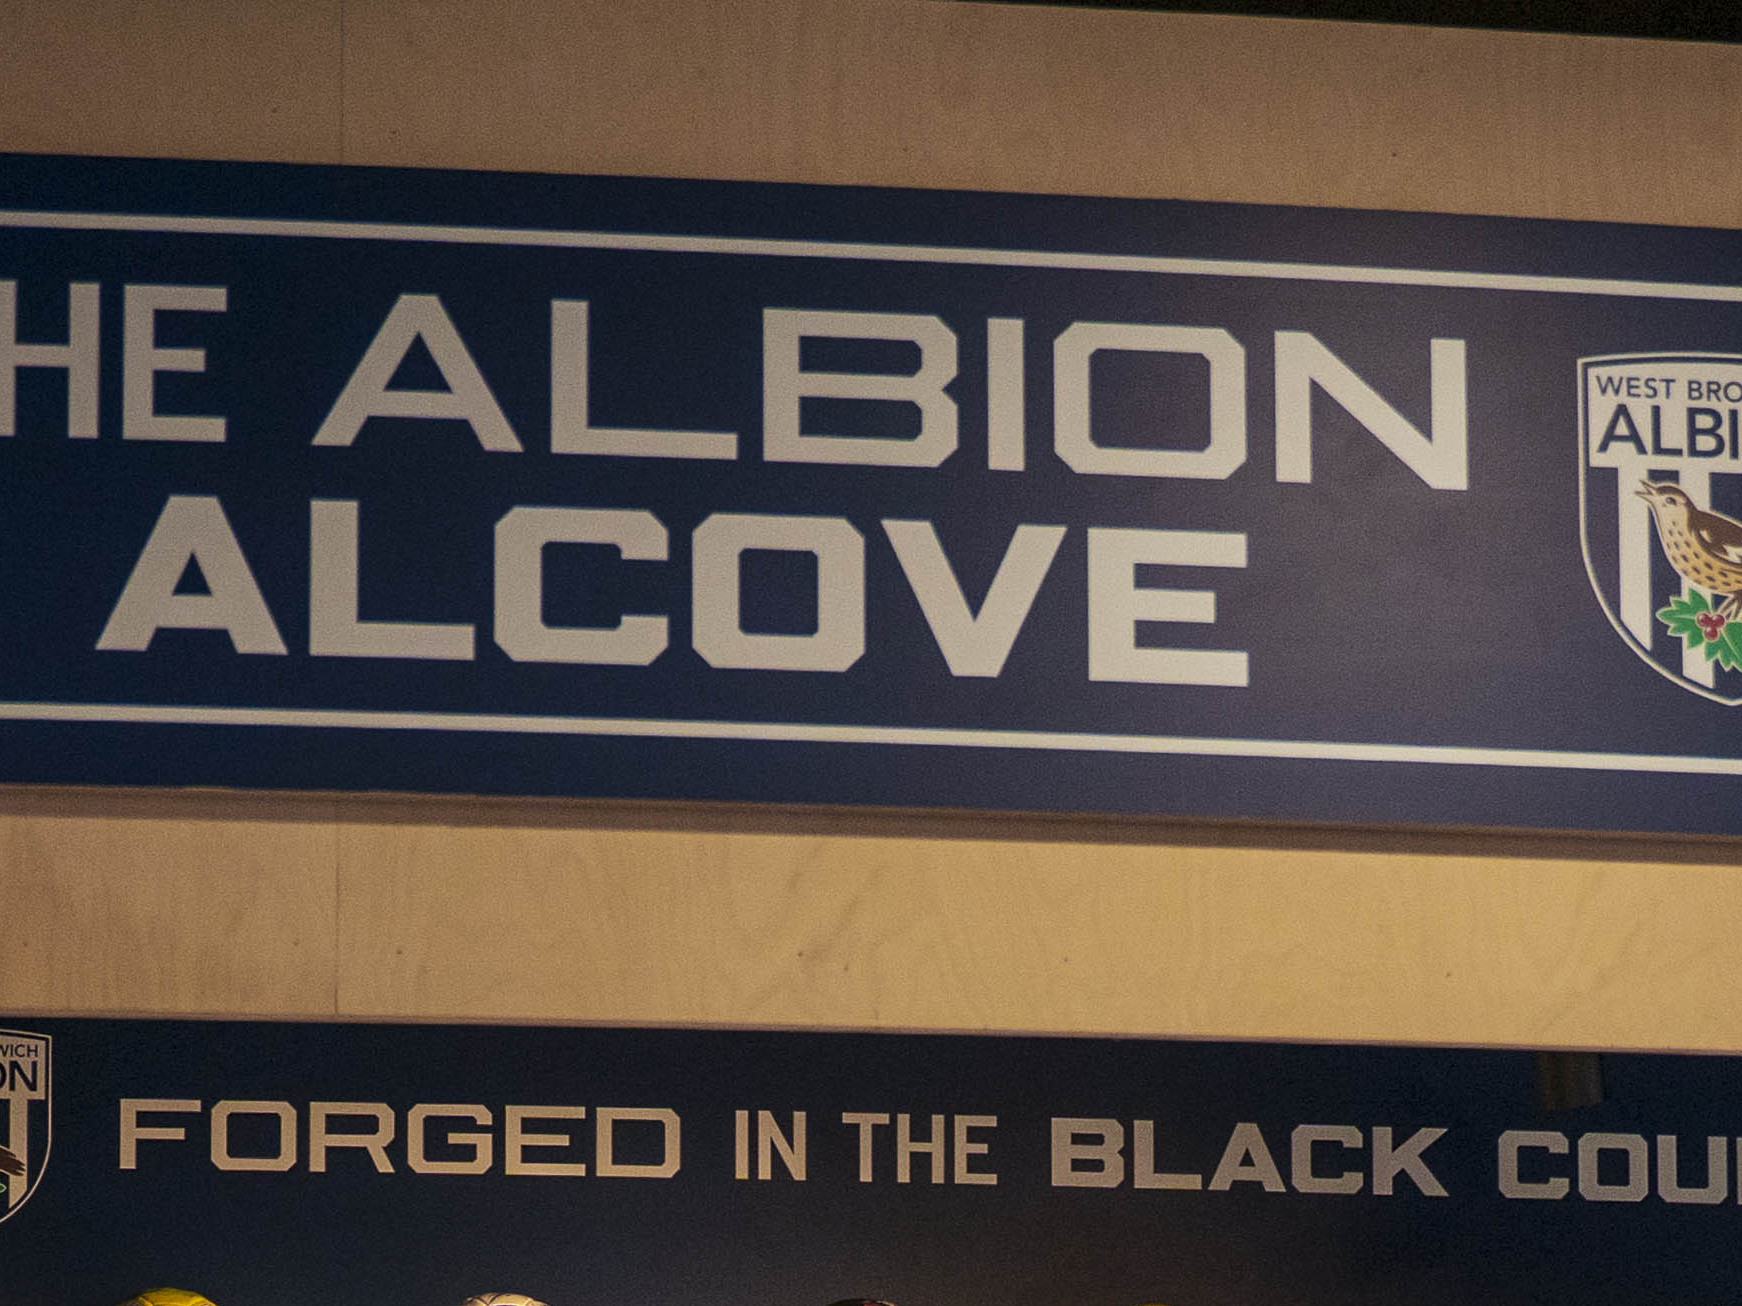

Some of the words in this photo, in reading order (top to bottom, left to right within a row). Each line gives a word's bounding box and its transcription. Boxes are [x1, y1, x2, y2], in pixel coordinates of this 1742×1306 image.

[311, 293, 1467, 491] ALBION
[1596, 376, 1676, 399] WEST
[96, 496, 1250, 687] ALCOVE
[119, 1099, 680, 1178] FORGED
[734, 1110, 807, 1181] IN
[841, 1112, 998, 1186] THE
[1050, 1117, 1449, 1197] BLACK
